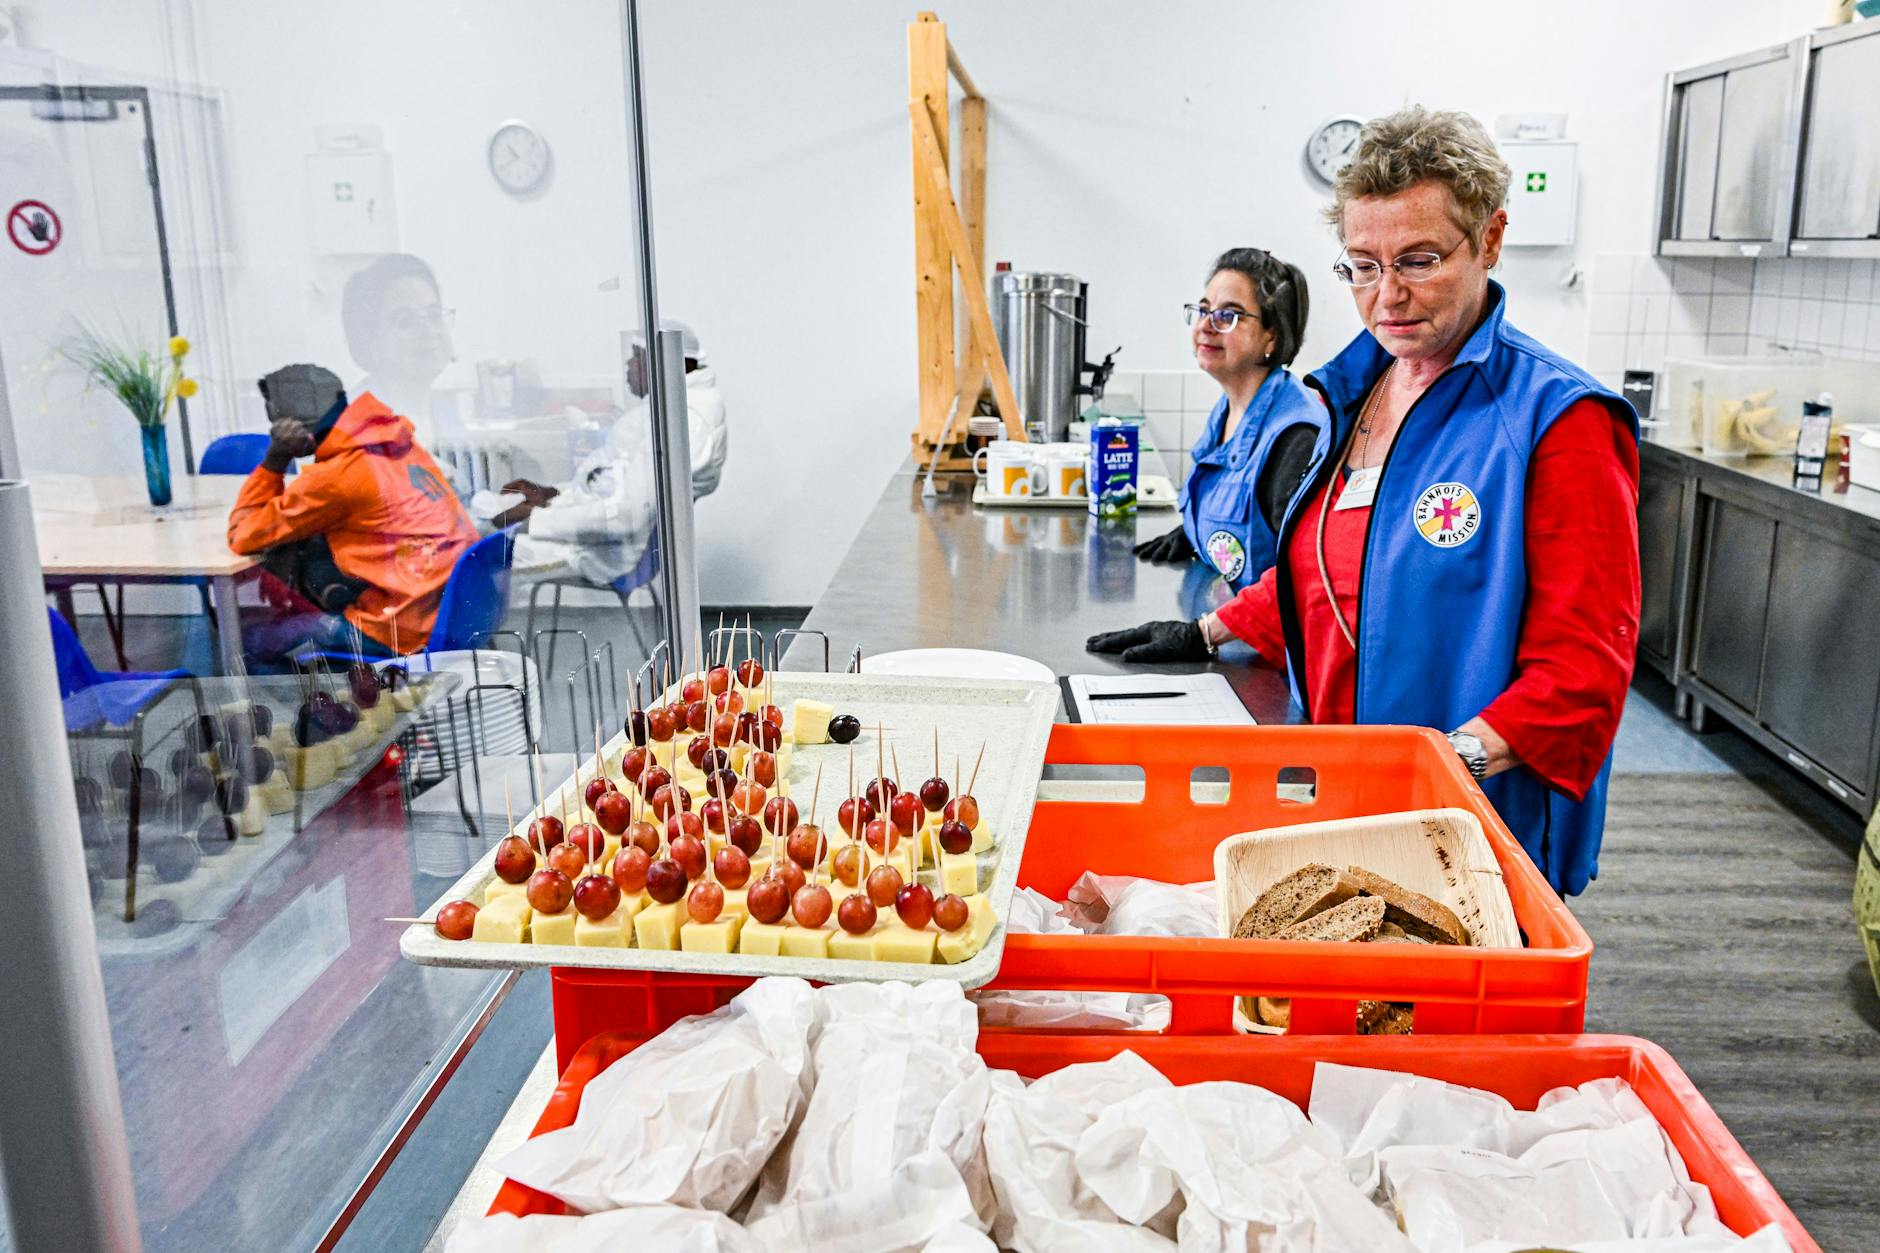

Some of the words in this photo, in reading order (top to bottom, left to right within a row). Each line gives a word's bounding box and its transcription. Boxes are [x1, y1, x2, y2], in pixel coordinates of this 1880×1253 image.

[1103, 451, 1134, 464] LATTE
[1418, 486, 1462, 519] BAHNHOFS
[1438, 513, 1477, 543] MISSION
